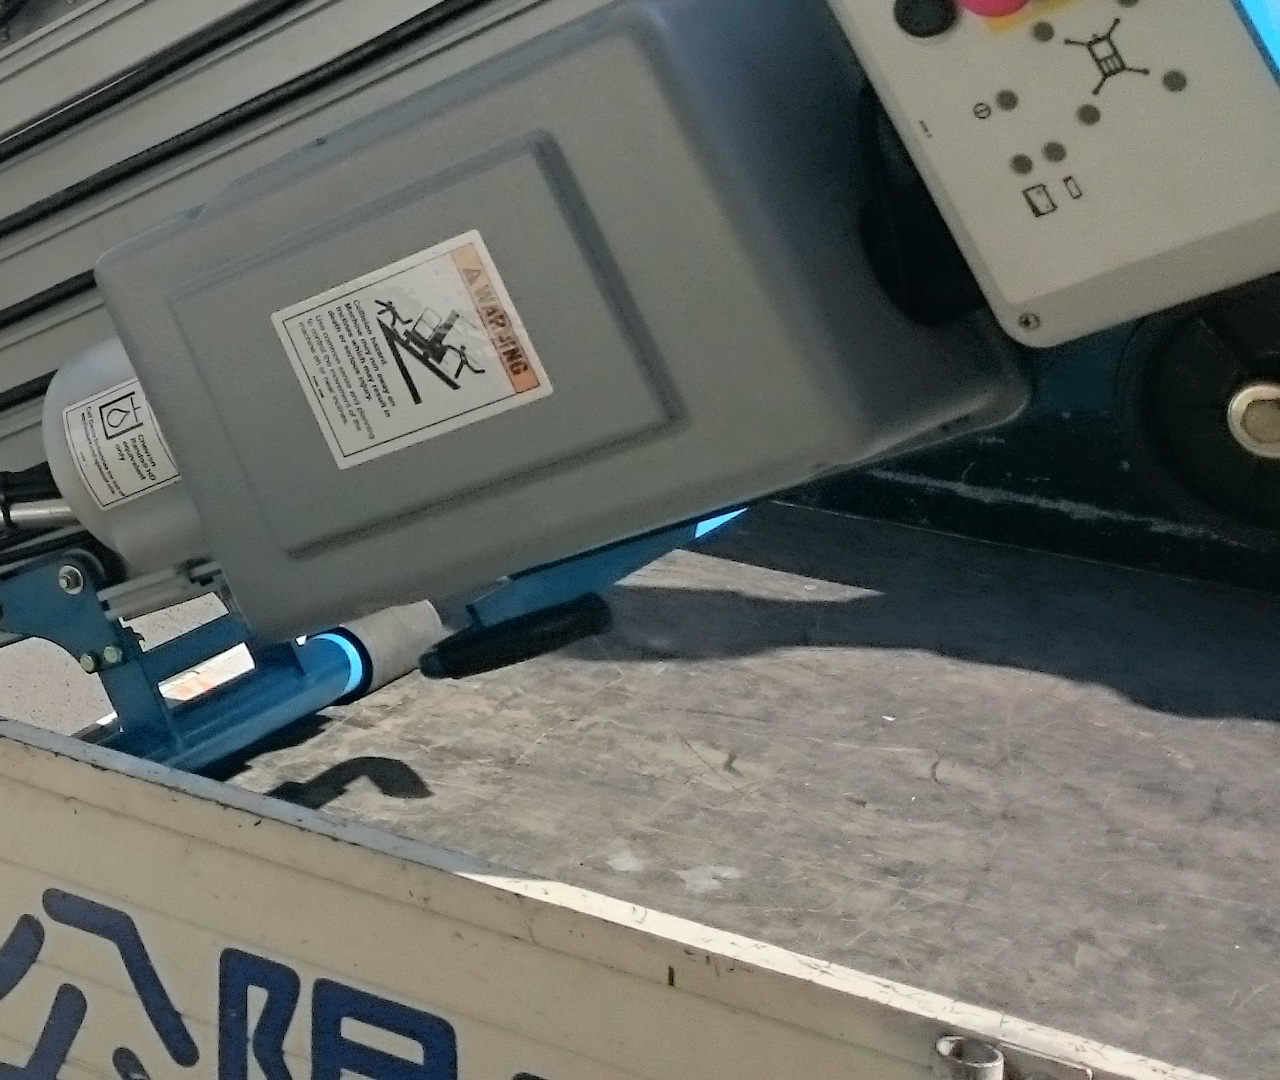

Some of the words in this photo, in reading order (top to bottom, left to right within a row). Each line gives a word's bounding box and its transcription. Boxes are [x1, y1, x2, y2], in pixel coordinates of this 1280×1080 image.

[326, 308, 343, 333] death
[337, 332, 347, 344] or
[342, 344, 362, 376] serious
[356, 375, 373, 402] injury.
[334, 305, 355, 338] inclines
[349, 338, 367, 364] which
[361, 364, 375, 383] may
[369, 383, 387, 409] result
[343, 301, 364, 337] Machine
[359, 337, 373, 356] may
[367, 356, 380, 372] run
[374, 372, 390, 395] away
[385, 395, 396, 408] on
[351, 298, 374, 336] Collision
[475, 283, 530, 378] WARNING
[297, 320, 318, 354] machine
[312, 353, 323, 366] on
[321, 375, 336, 395] near
[330, 394, 350, 426] inclines.
[310, 326, 327, 354] control
[322, 353, 334, 368] the
[328, 367, 352, 409] movement
[351, 418, 362, 432] the
[314, 313, 327, 331] Use
[321, 330, 342, 366] common
[336, 364, 353, 390] sense
[347, 389, 361, 406] and
[355, 405, 376, 440] planning
[112, 442, 127, 462] only
[121, 439, 146, 482] equivalent
[136, 433, 156, 468] Chevron
[145, 467, 156, 482] HD
